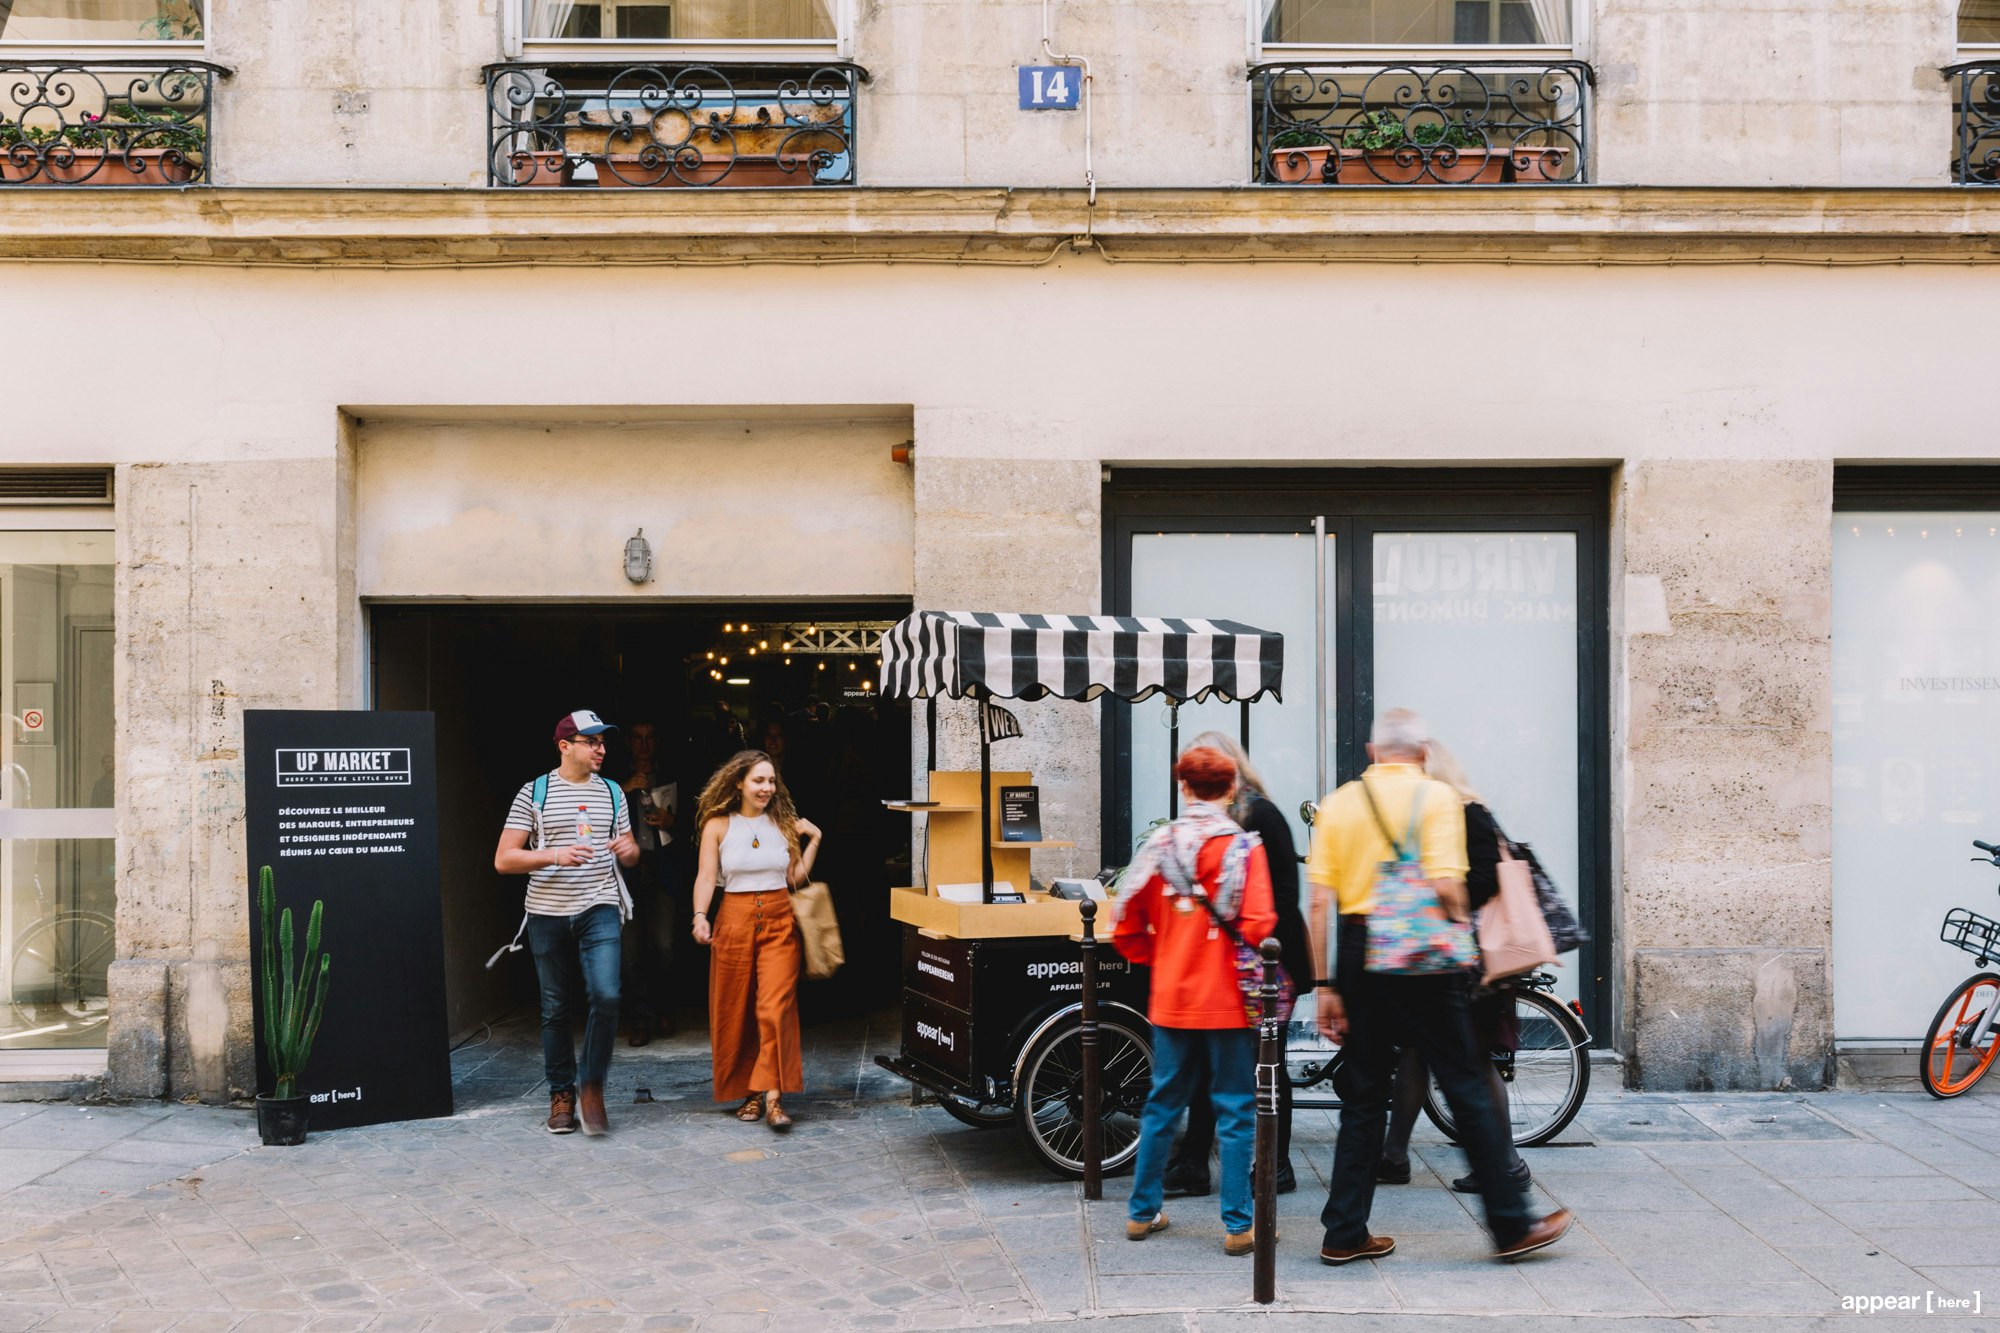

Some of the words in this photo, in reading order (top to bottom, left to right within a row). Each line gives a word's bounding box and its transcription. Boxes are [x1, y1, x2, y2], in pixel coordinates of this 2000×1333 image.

[1031, 71, 1069, 104] 14
[296, 752, 318, 771] UP
[324, 751, 391, 771] MARKET
[278, 807, 331, 816] DÉCOUVREZ
[345, 806, 386, 814] MEILLEUR
[298, 820, 344, 829] MARQUES,
[345, 818, 415, 828] ENTREPRENEURS
[279, 835, 290, 843] ET
[292, 834, 341, 843] DESIGNERS
[342, 832, 407, 841] INDÉPENDANTS
[280, 848, 312, 857] RÉUNIS
[314, 847, 326, 855] AU
[355, 846, 368, 854] DU
[370, 845, 406, 854] MARAIS.
[916, 1021, 938, 1039] appear
[310, 1093, 330, 1103] ear
